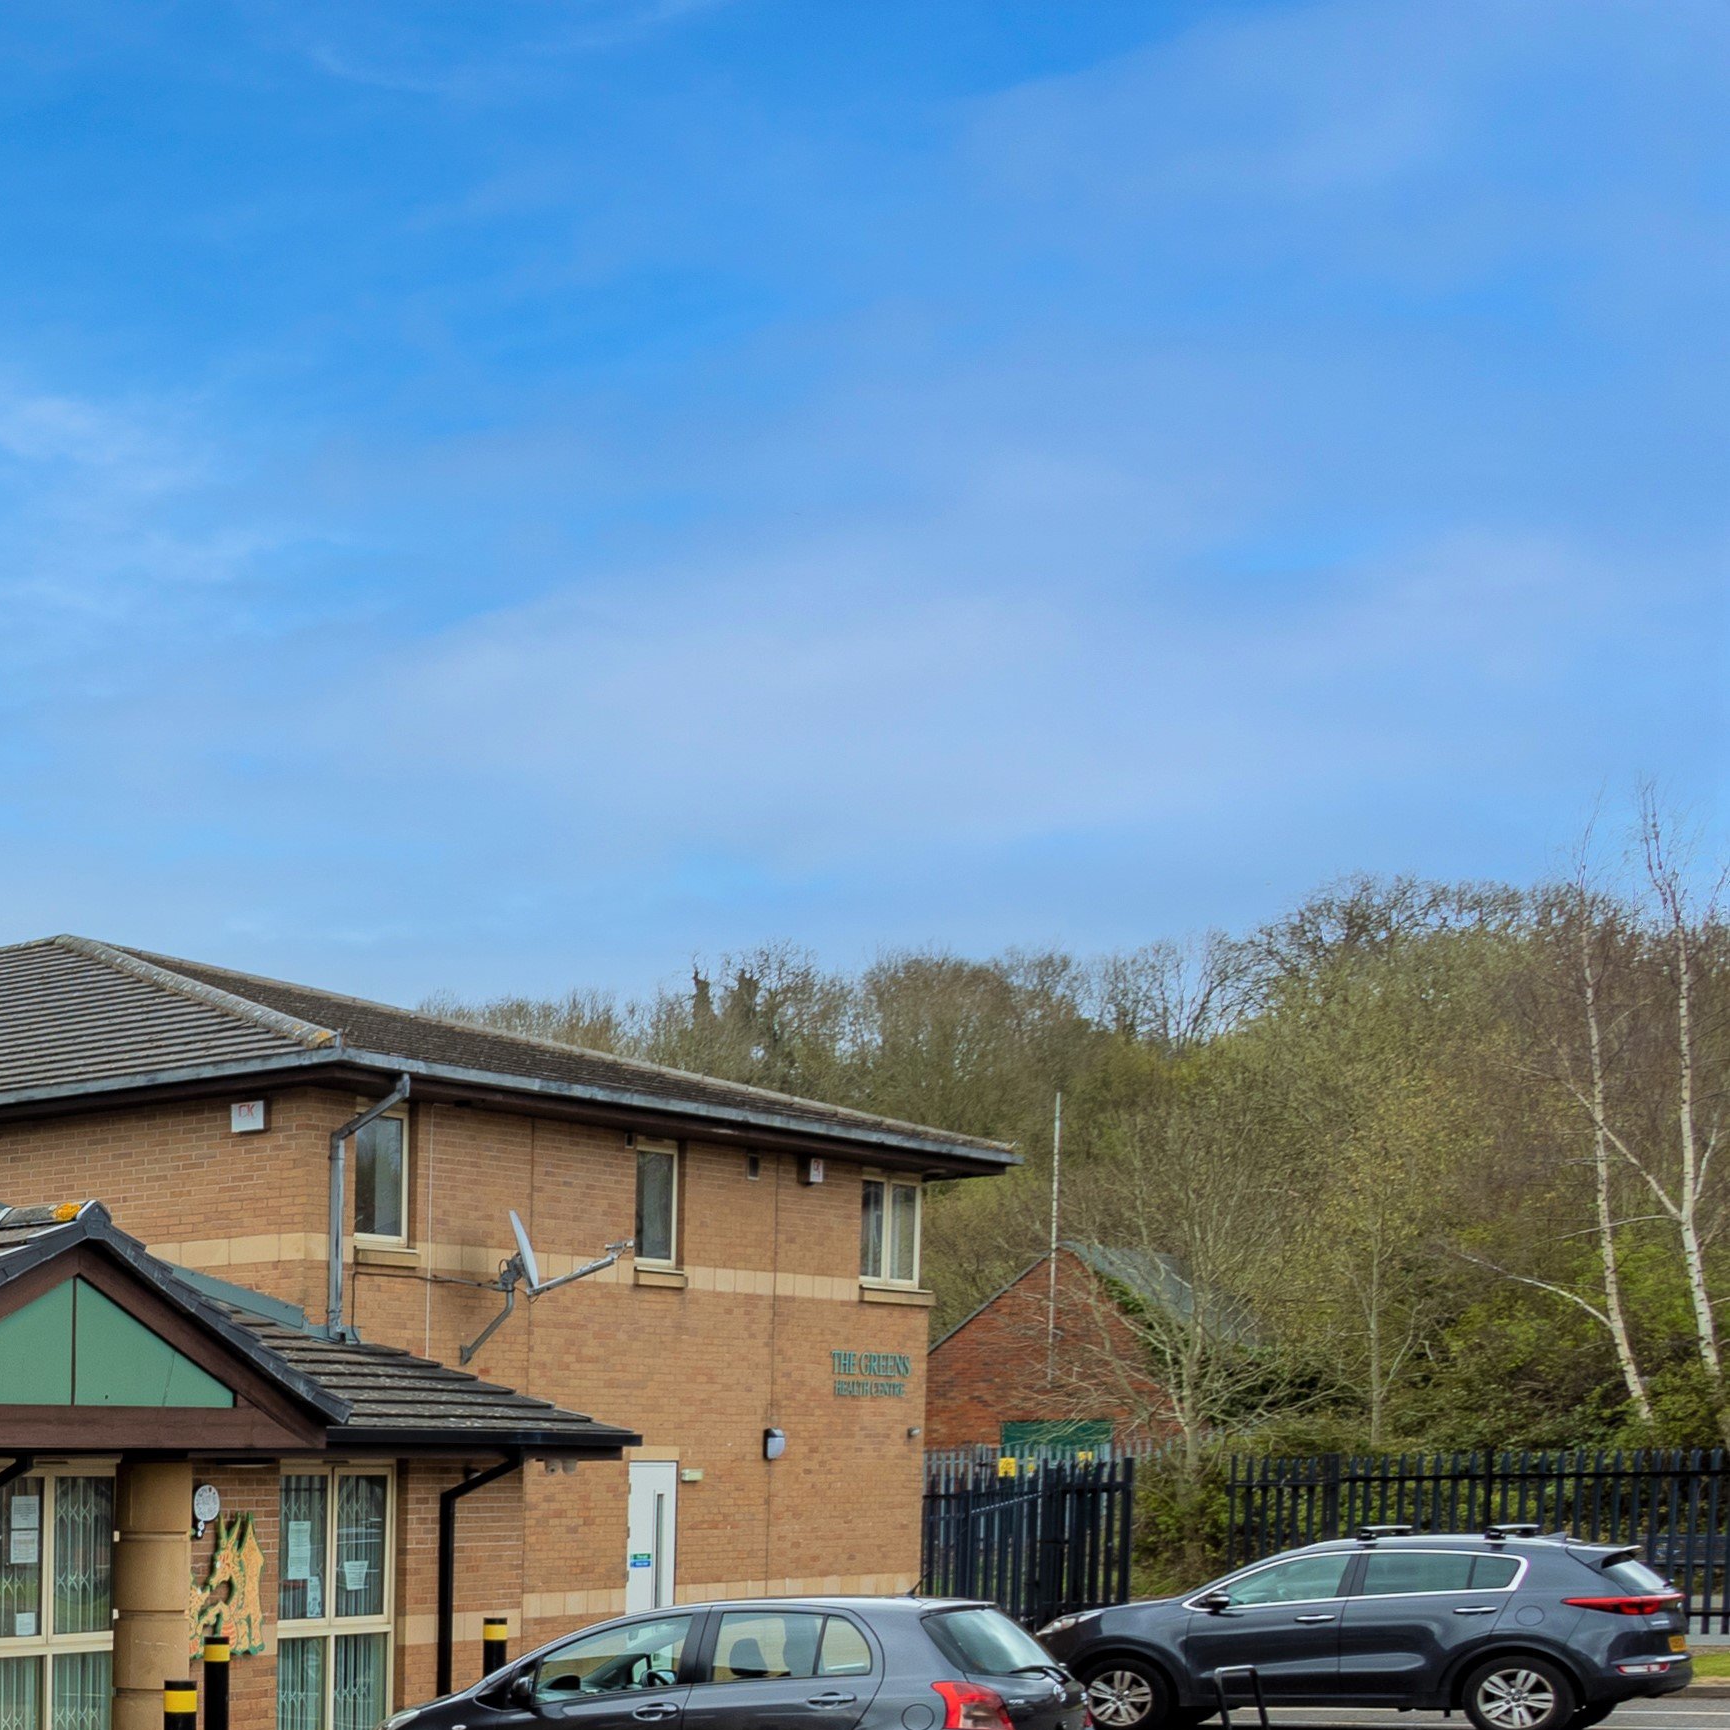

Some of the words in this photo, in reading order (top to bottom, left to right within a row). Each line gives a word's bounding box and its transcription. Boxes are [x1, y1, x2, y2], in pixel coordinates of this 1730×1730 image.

[831, 1349, 857, 1375] THE
[860, 1352, 911, 1377] GREENS
[835, 1380, 870, 1396] HEALTH
[871, 1381, 906, 1397] CENTRE
